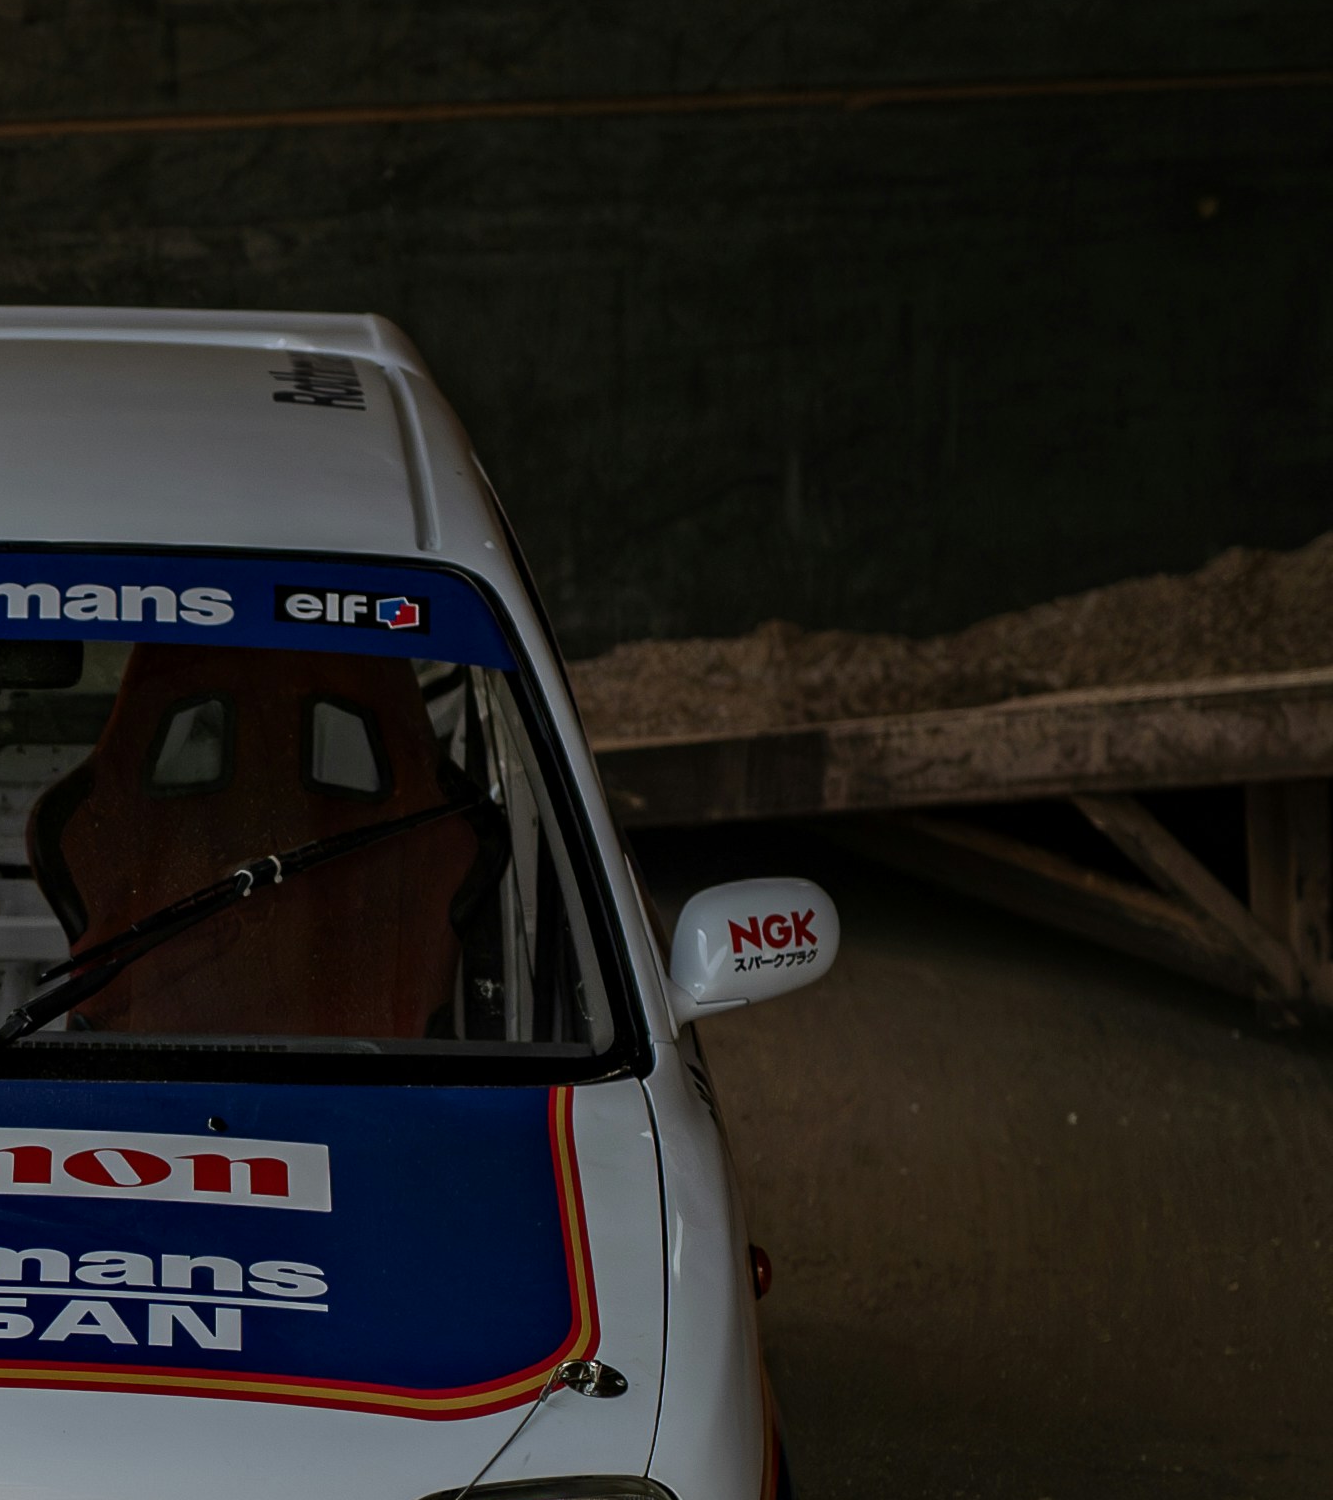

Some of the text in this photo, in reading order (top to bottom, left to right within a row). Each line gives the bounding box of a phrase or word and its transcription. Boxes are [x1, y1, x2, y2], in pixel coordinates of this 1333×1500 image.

[285, 593, 368, 624] elf
[727, 908, 818, 954] NGK
[734, 948, 819, 973] スパークプラグ
